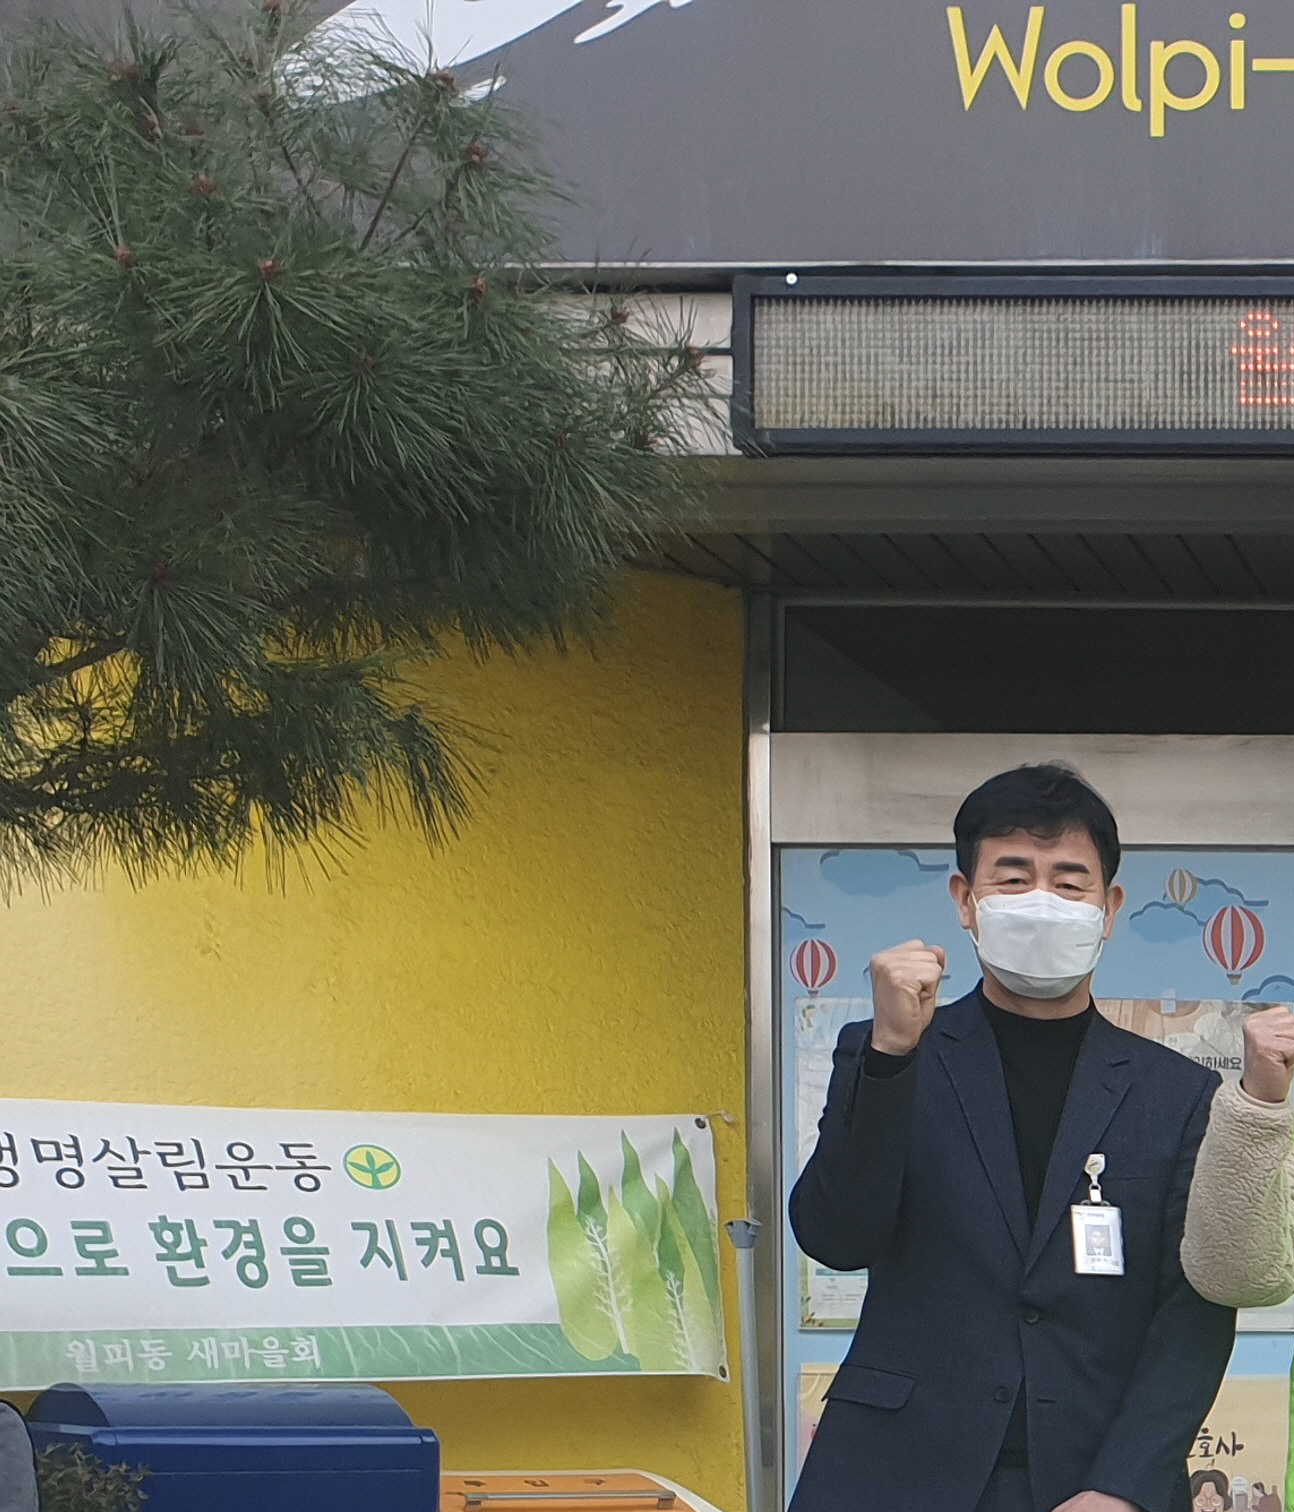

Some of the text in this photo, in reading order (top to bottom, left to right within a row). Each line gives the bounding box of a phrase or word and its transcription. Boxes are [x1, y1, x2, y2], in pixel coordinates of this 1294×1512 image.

[6, 1214, 521, 1290] 으로 환경을 지켜요
[64, 1335, 323, 1374] 월피동 새마을회
